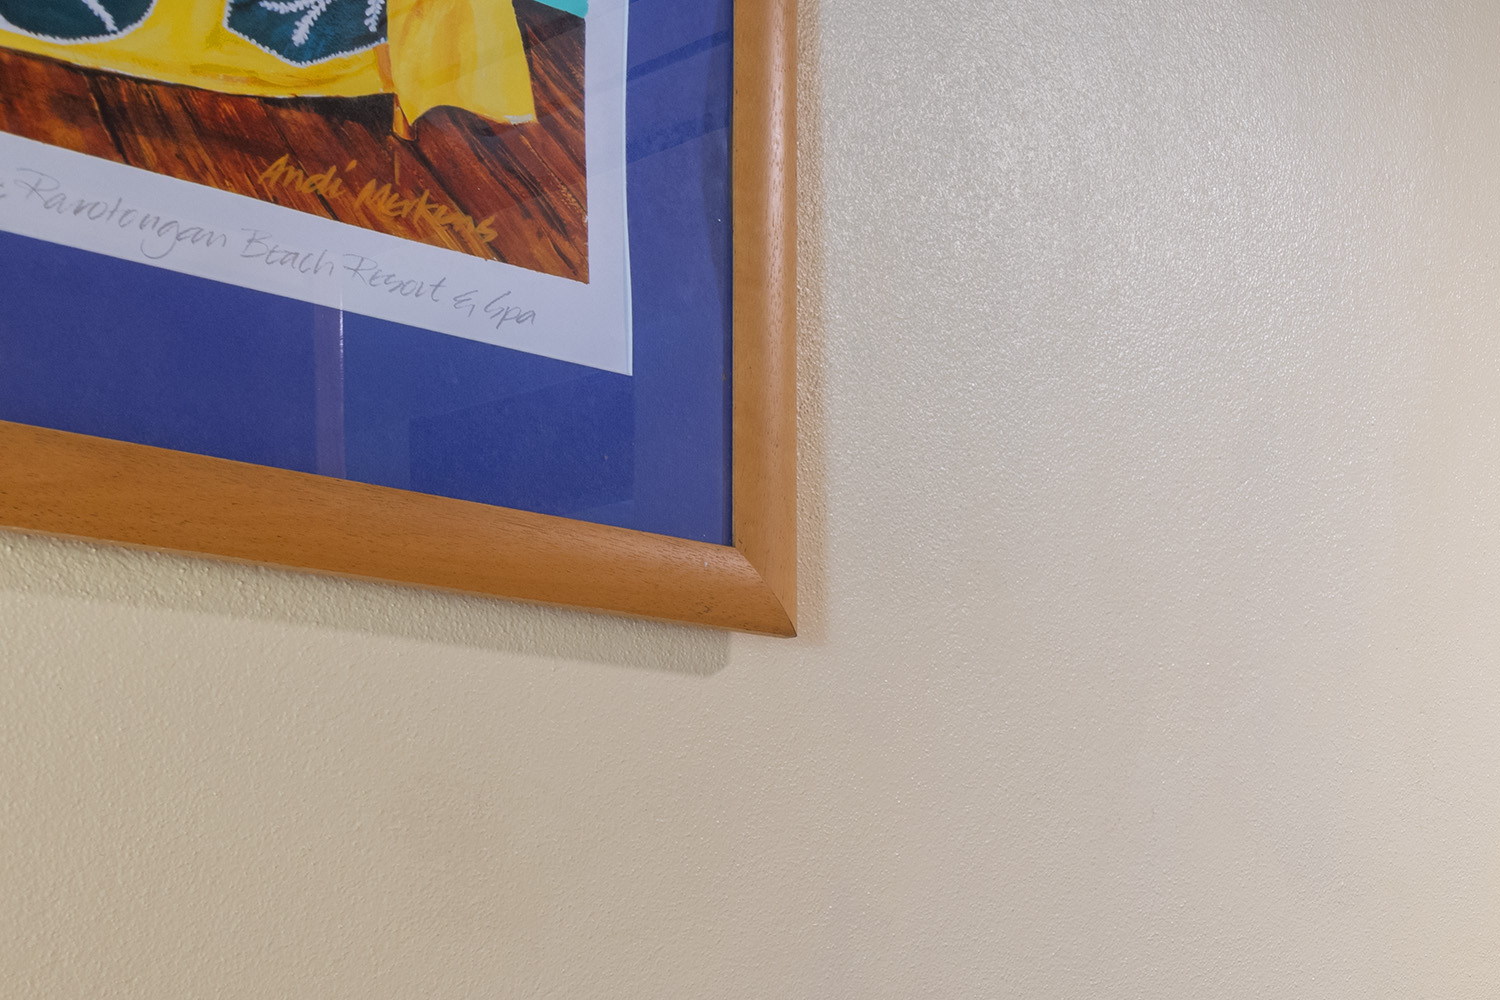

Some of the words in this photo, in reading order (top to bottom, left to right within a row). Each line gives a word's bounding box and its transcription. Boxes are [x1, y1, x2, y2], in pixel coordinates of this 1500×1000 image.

[258, 153, 358, 198] Andi
[239, 227, 335, 276] Beach
[342, 252, 447, 303] Resort
[483, 290, 537, 330] Spa
